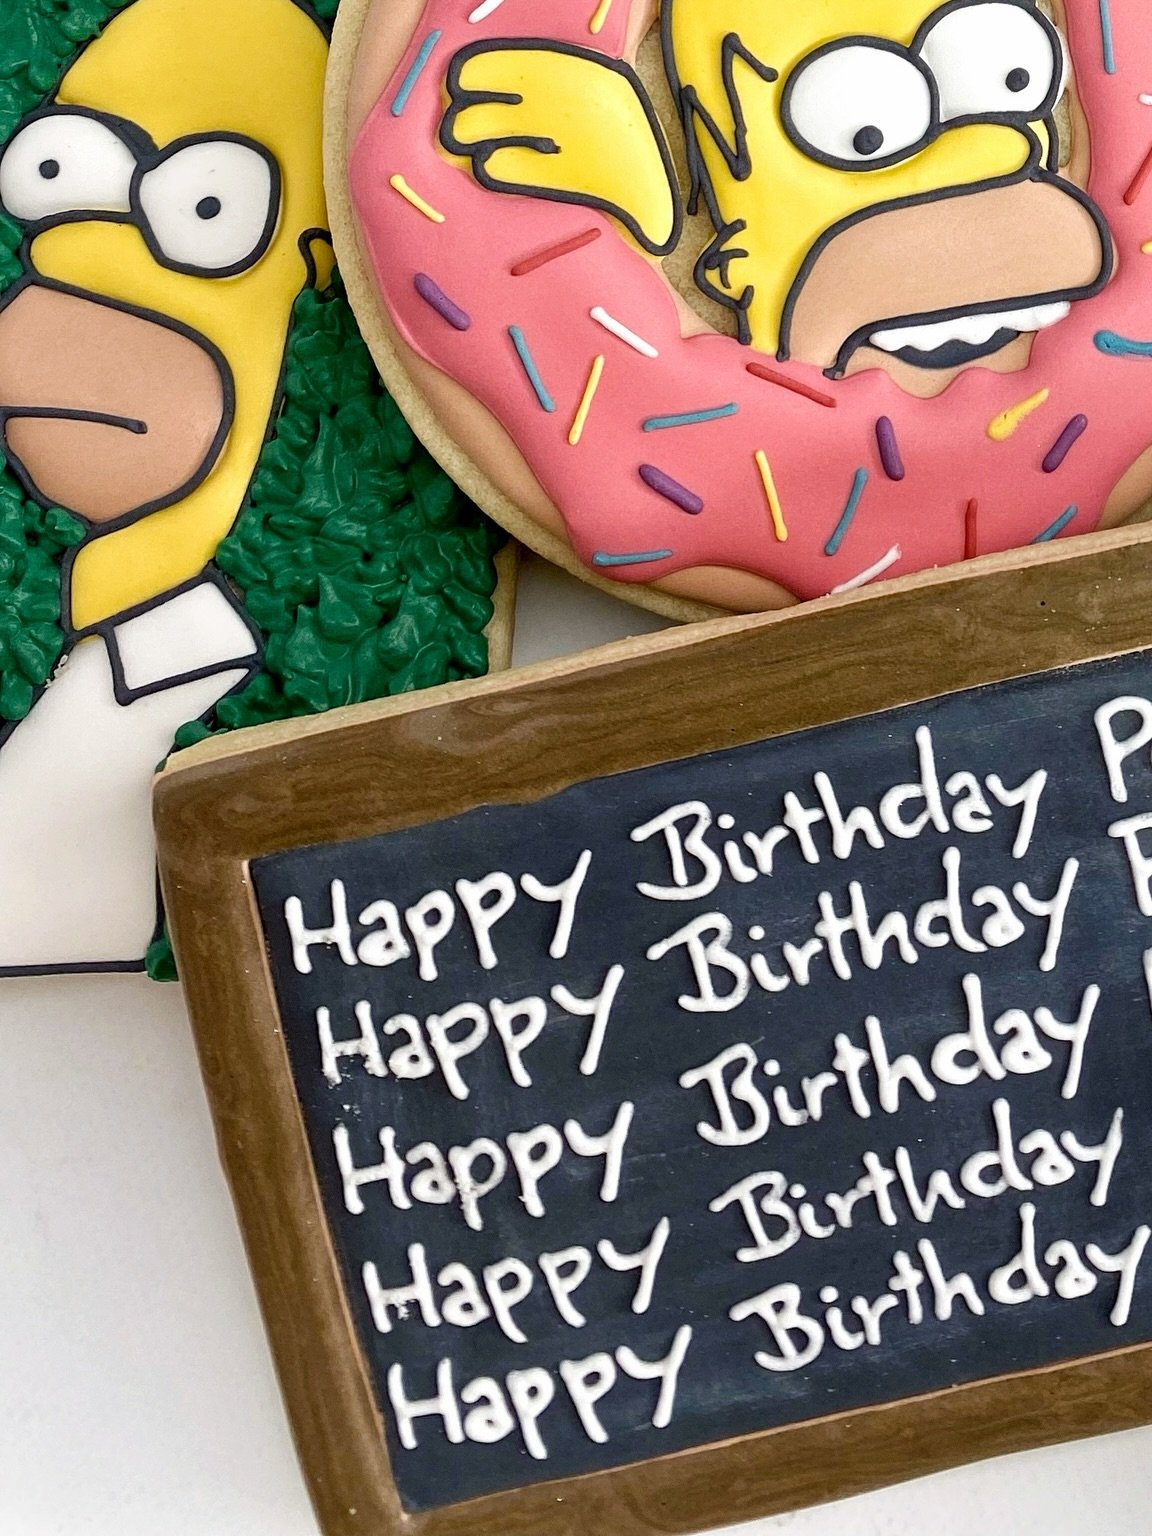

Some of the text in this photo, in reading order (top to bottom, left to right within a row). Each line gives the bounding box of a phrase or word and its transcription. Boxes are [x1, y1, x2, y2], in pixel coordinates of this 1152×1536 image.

[285, 849, 592, 981] Happy
[630, 726, 1047, 901] Birthday
[316, 964, 624, 1100] Happy
[646, 847, 1079, 1013] Birthday
[333, 1101, 634, 1230] Happy
[679, 973, 1101, 1146] Birthday
[362, 1217, 671, 1343] Happy
[709, 1098, 1124, 1263] Birthday
[387, 1325, 692, 1459] Happy
[730, 1202, 1151, 1372] Birthday
